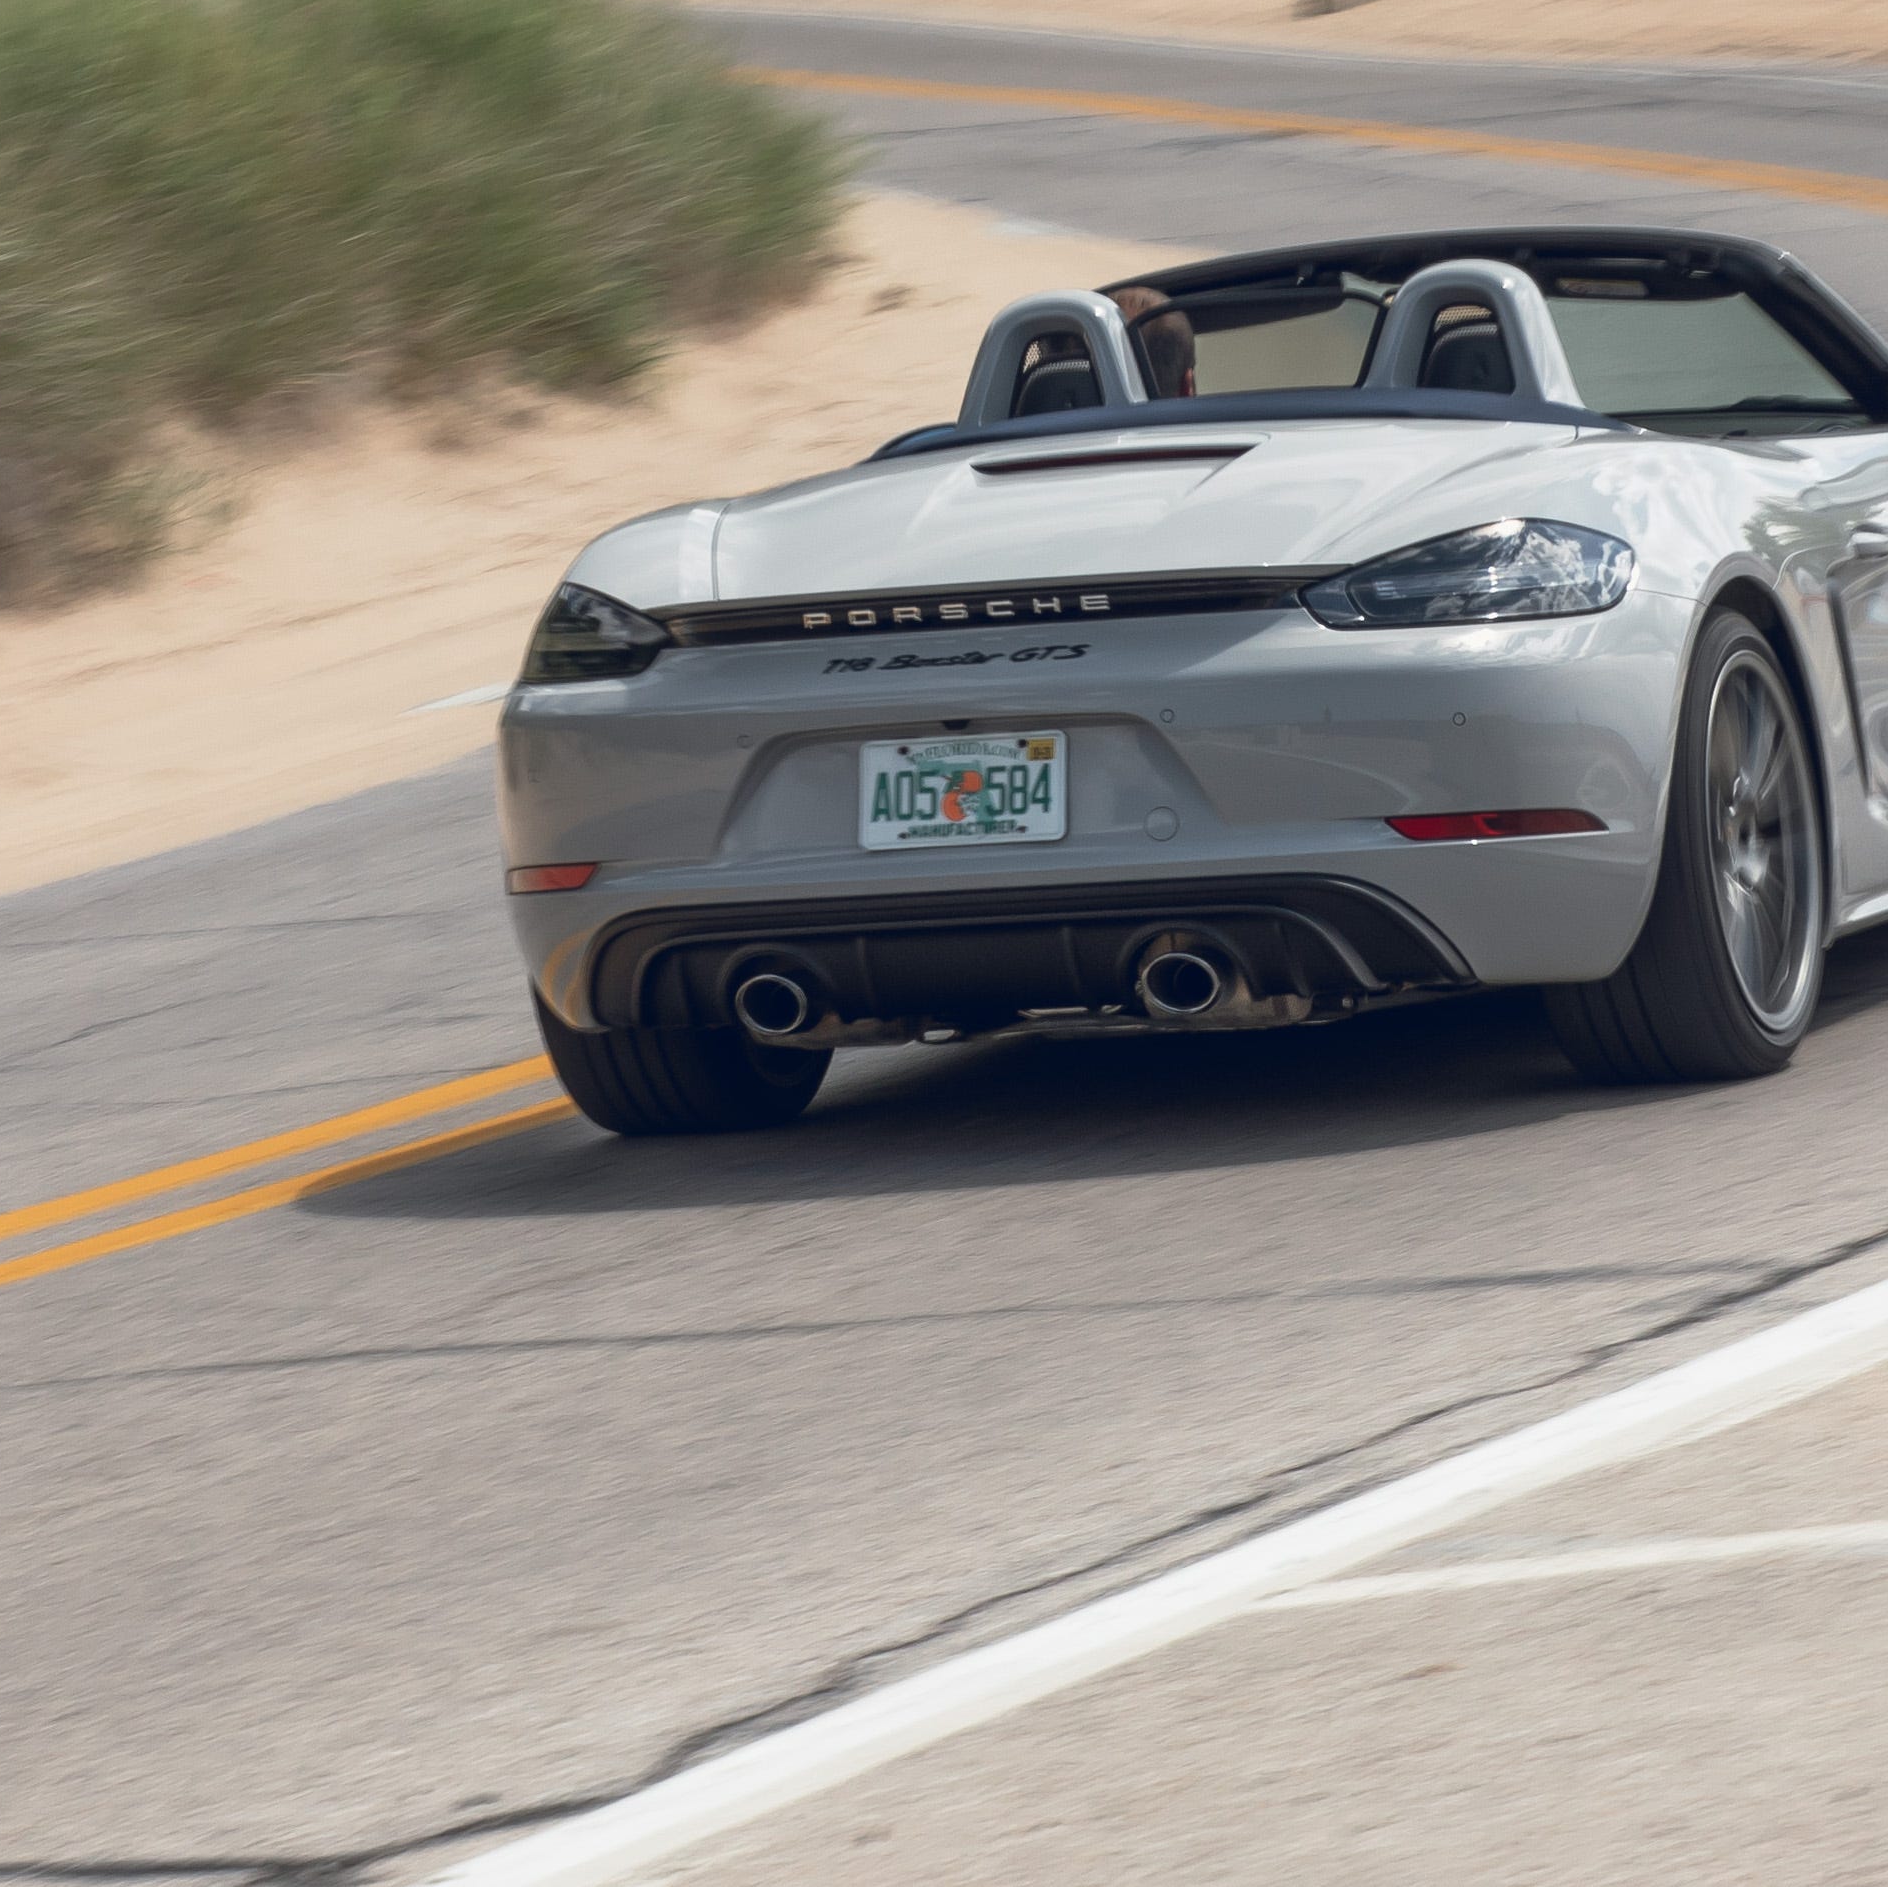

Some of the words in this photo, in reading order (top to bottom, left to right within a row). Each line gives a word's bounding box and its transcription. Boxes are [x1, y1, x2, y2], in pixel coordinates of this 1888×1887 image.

[803, 594, 1110, 629] PORSCHE
[1008, 643, 1092, 663] GTS
[984, 762, 1052, 816] 584
